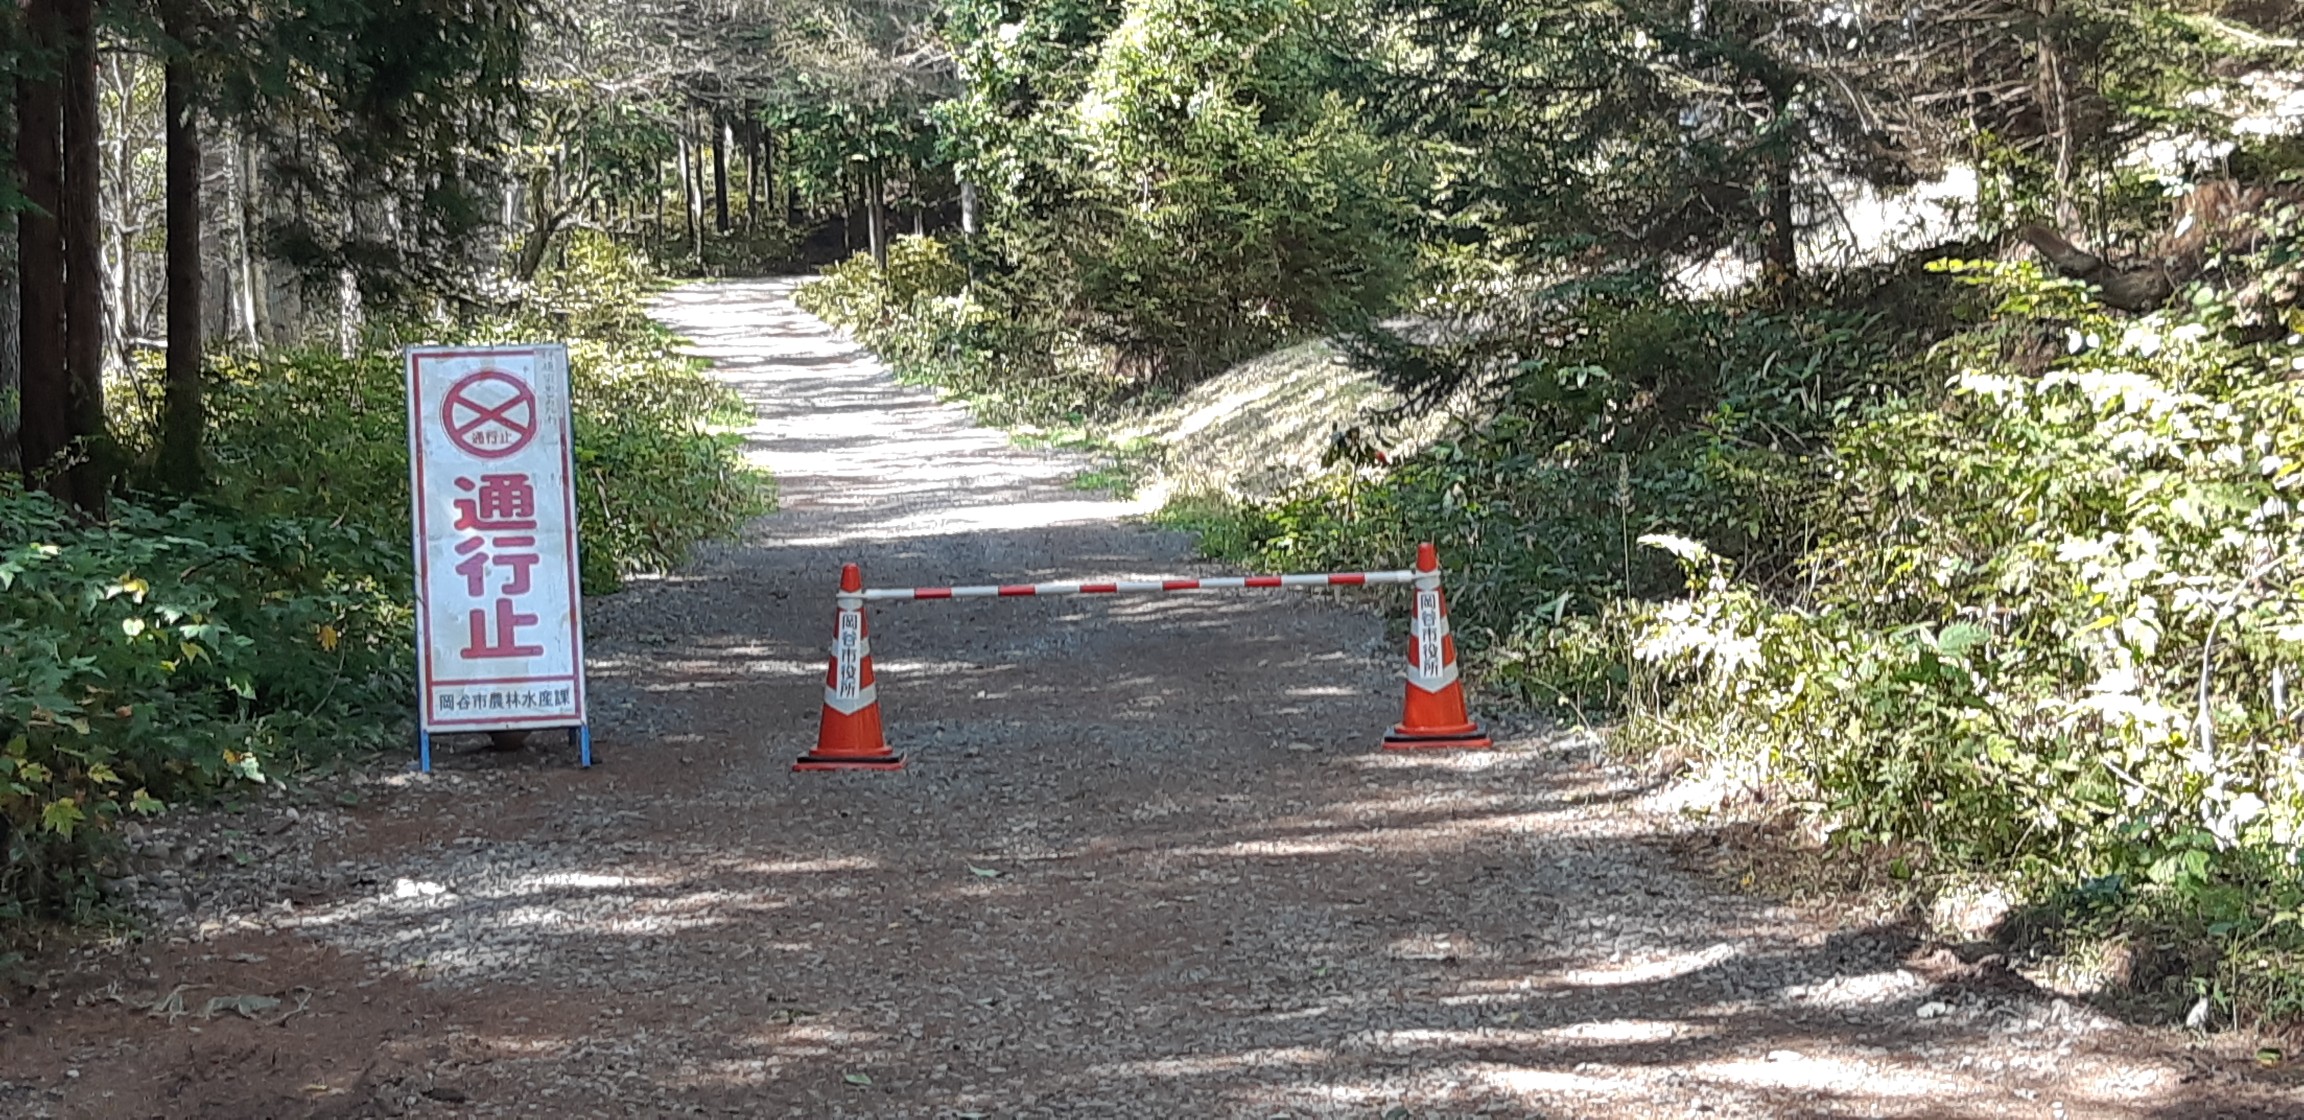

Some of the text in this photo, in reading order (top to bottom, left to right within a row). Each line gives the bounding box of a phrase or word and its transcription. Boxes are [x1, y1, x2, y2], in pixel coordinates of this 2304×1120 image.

[471, 430, 513, 445] 通行止
[453, 473, 545, 659] 通行止
[839, 614, 858, 698] 岡谷市役所
[1420, 593, 1439, 677] 岡谷市役所
[439, 687, 571, 711] 岡谷市農林水産課
